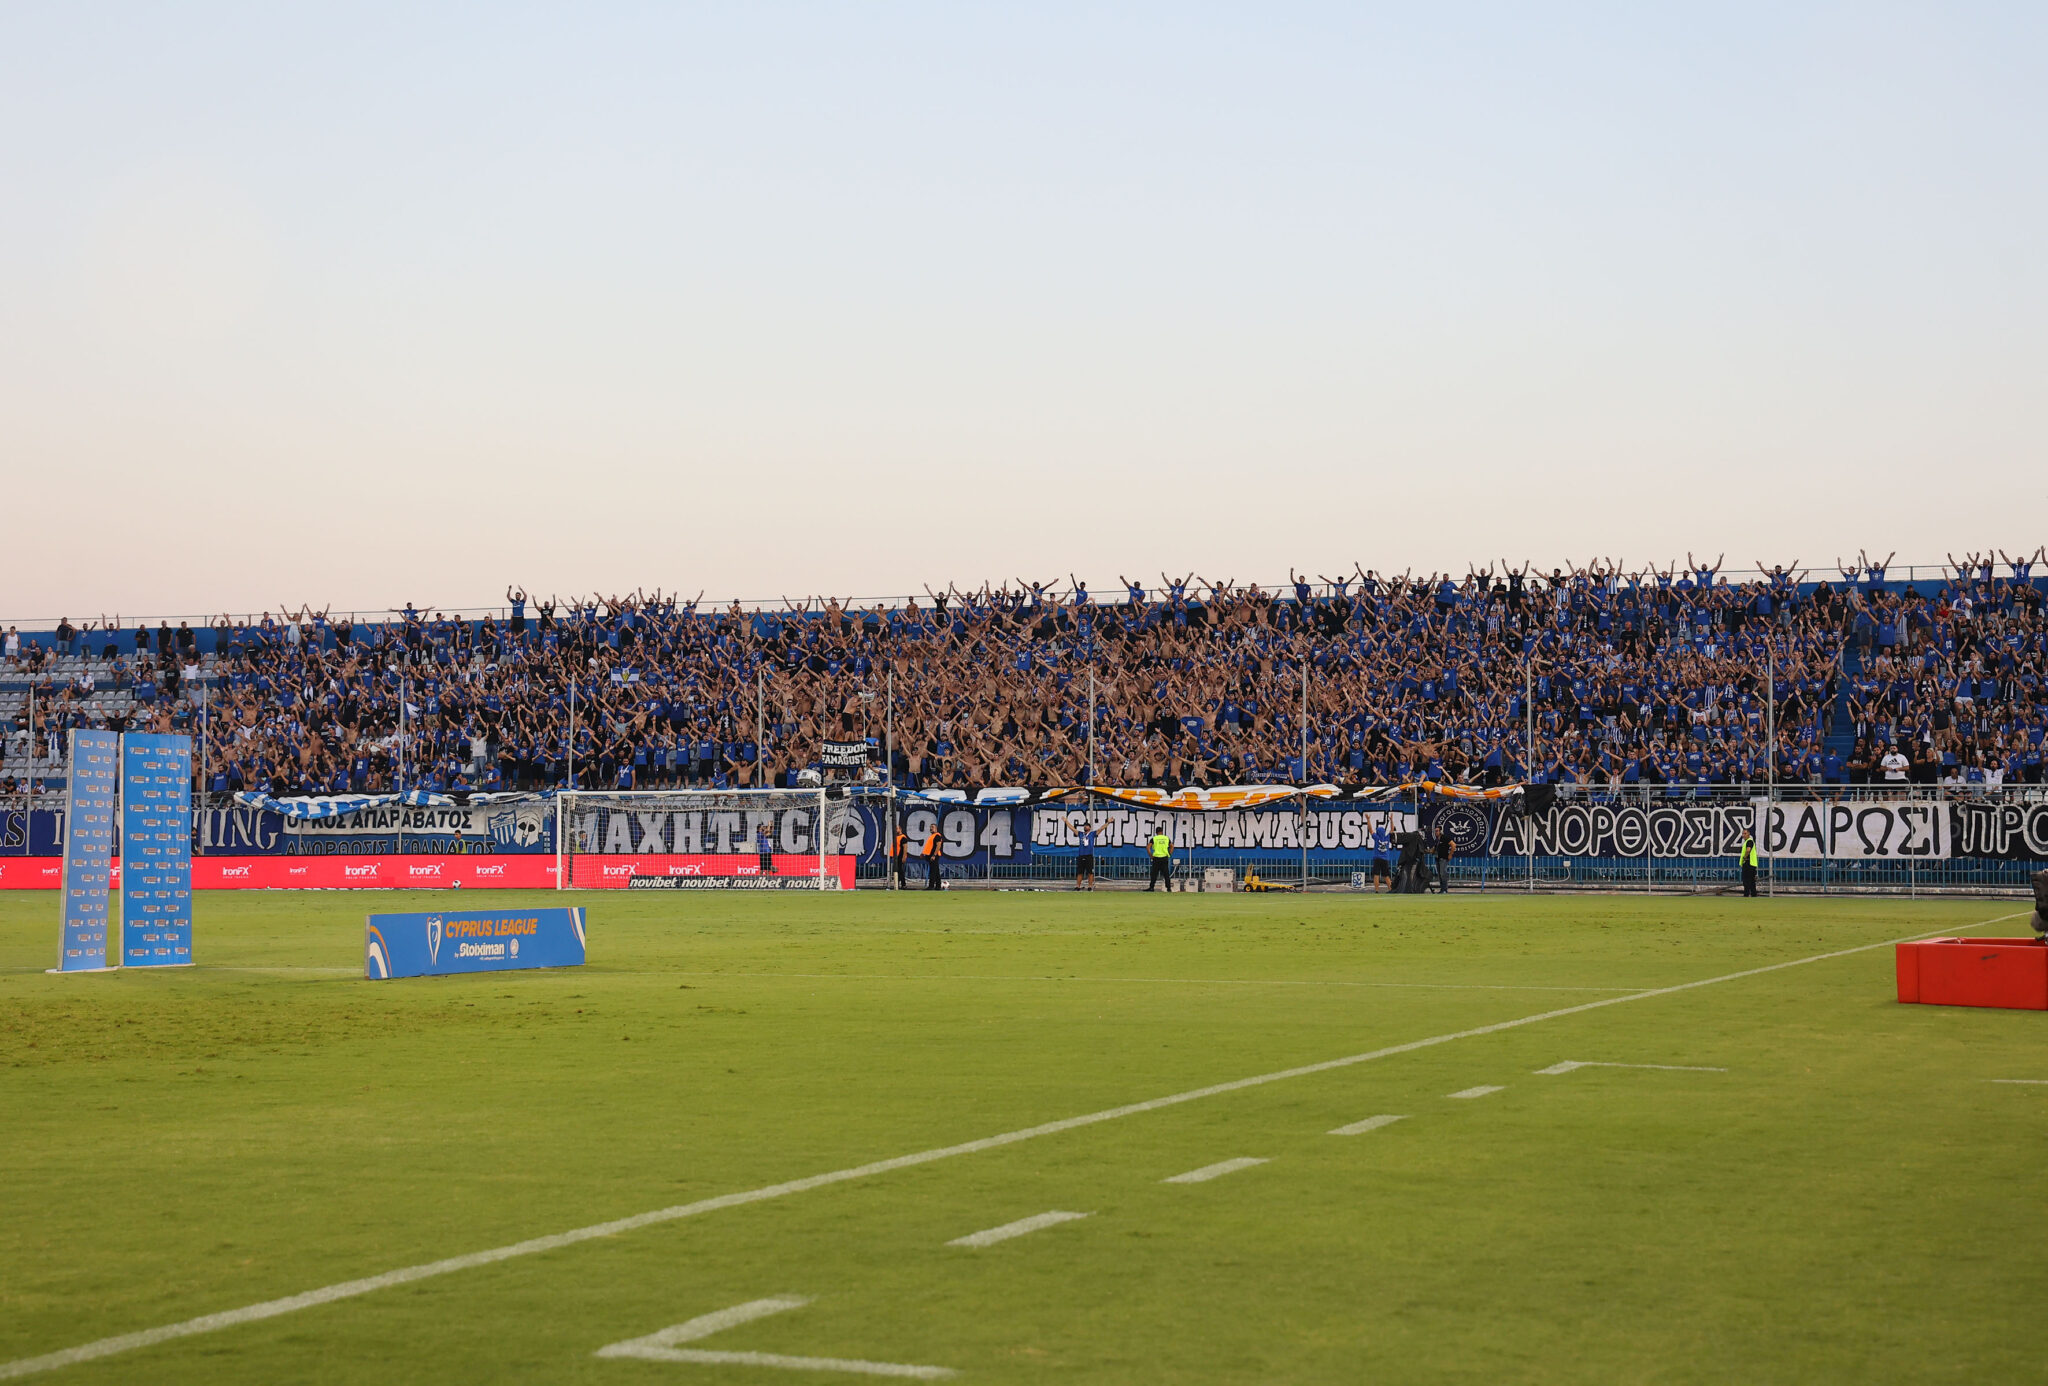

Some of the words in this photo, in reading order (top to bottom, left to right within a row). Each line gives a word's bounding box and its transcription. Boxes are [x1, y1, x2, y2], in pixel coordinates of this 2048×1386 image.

[822, 743, 867, 754] FREEDOM
[351, 809, 473, 830] ΑΠΑΡΑΒΑΤΟΣ
[1763, 805, 1942, 856] ΒΑΡΩΣΙ
[222, 867, 251, 876] IronFX
[345, 865, 379, 876] IronFX
[409, 865, 443, 875] IronFX
[476, 865, 505, 875] IronFX
[603, 865, 637, 875] IronFX
[669, 865, 702, 875] IronFX
[738, 866, 760, 874] IronF
[630, 876, 677, 889] novibet
[681, 876, 730, 889] novibet
[733, 877, 783, 889] novibet
[786, 877, 835, 889] novibet
[445, 919, 493, 938] CYPRUS
[494, 917, 539, 936] LEAGUE
[460, 942, 505, 957] Stoiximan
